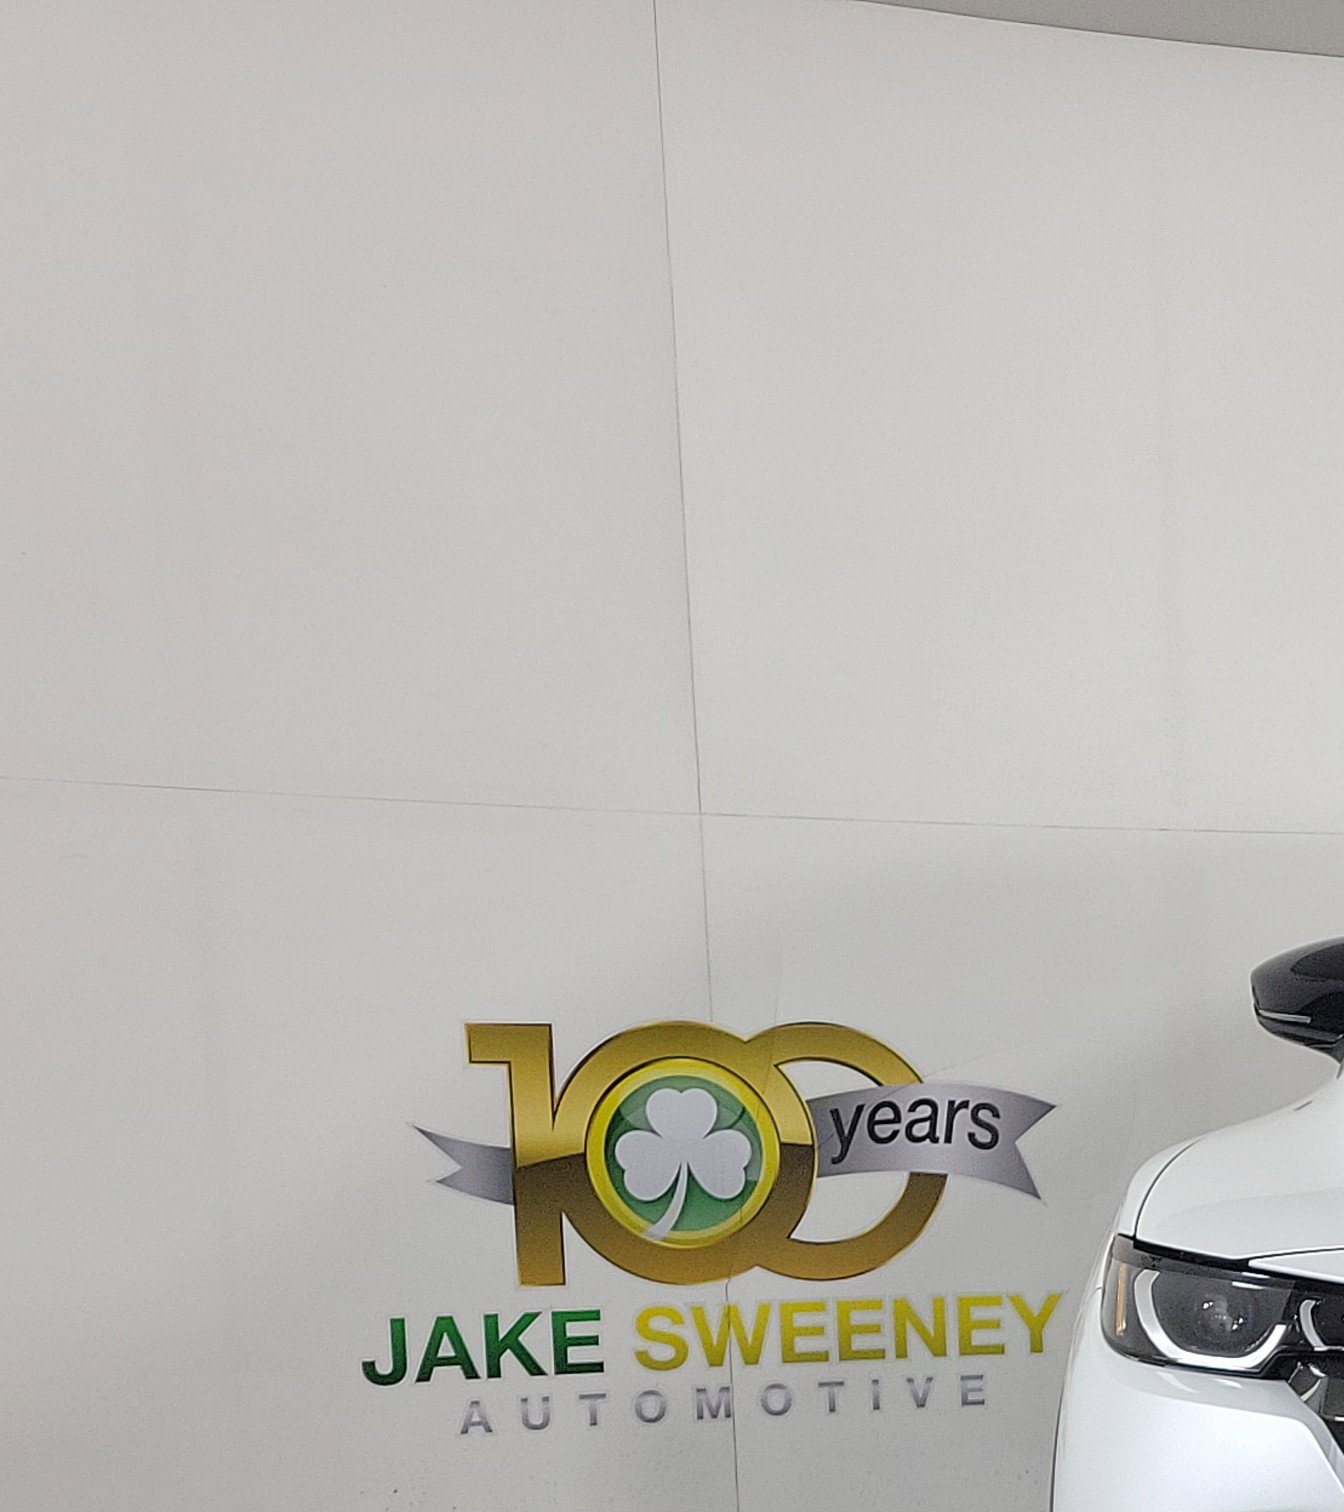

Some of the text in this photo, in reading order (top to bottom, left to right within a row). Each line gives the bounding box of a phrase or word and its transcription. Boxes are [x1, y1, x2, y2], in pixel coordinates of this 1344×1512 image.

[466, 1020, 1001, 1286] 100 years
[361, 1292, 1063, 1387] JAKE SWEENEY
[459, 1374, 987, 1436] AUTOMOTIVE
